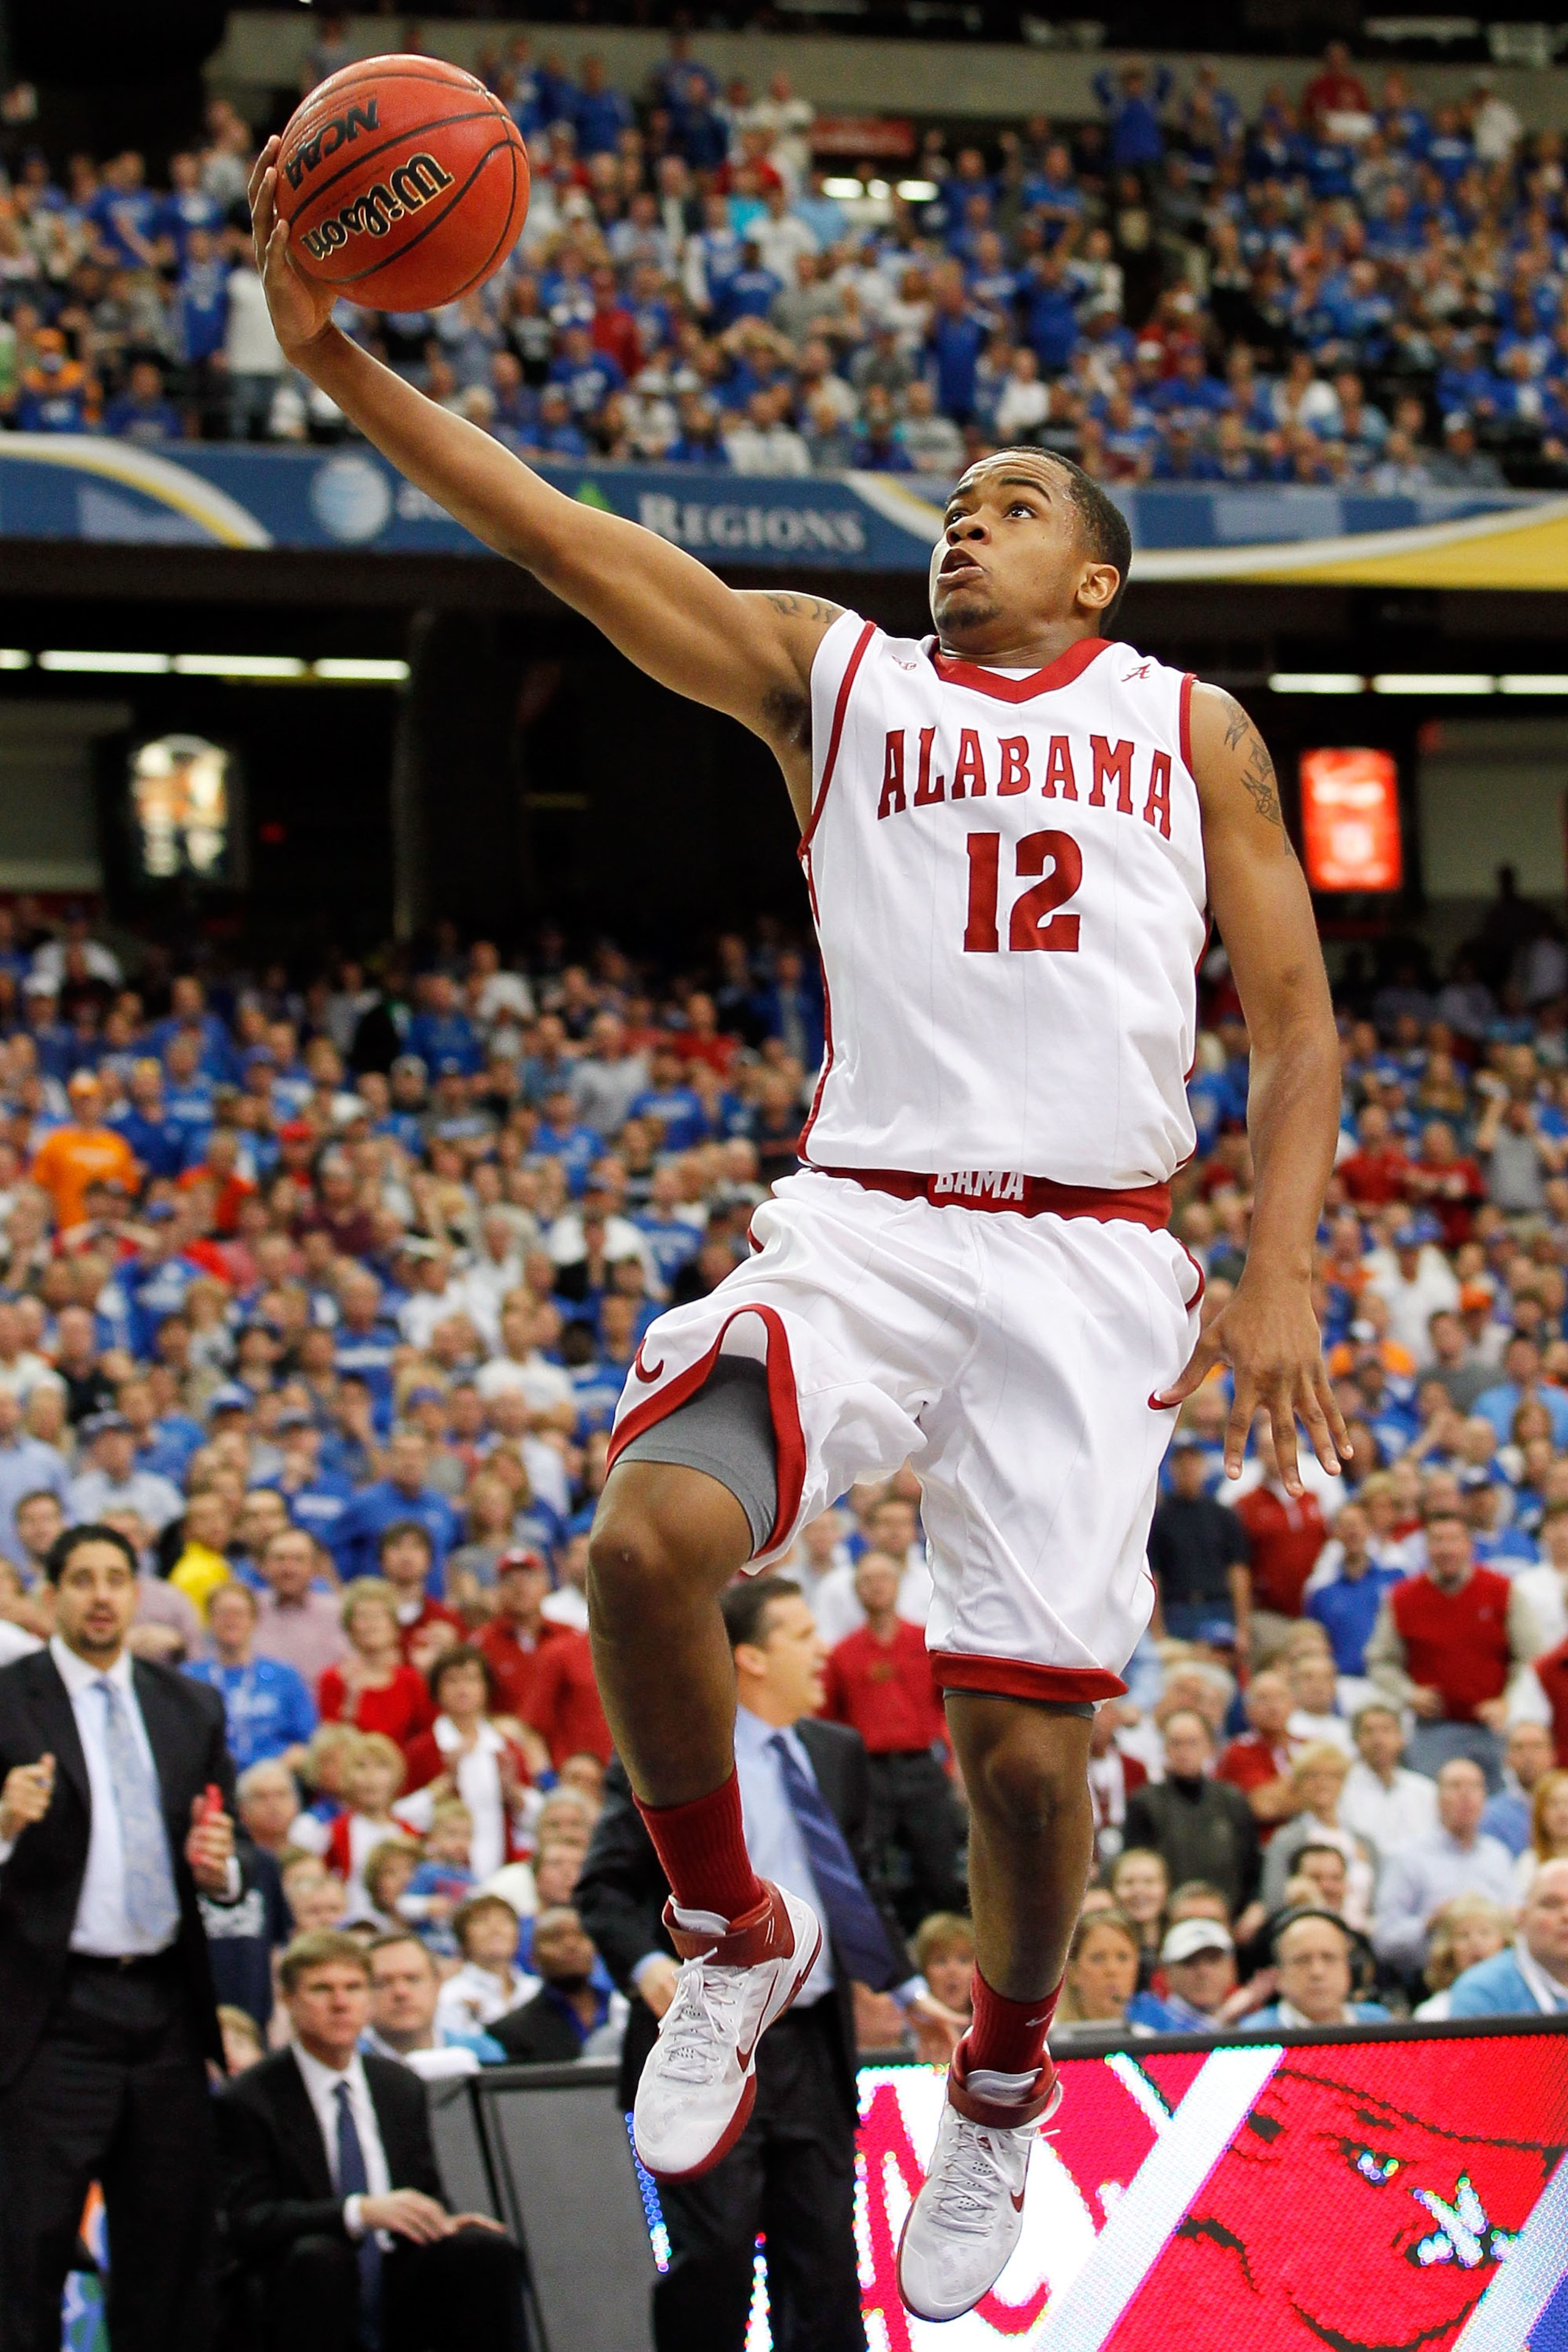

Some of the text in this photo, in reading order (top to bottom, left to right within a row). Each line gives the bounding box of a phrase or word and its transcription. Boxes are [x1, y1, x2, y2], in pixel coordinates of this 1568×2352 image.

[284, 99, 380, 190] NCAA
[300, 153, 455, 261] Wilson
[877, 726, 1172, 842] ALABAMA
[963, 829, 1083, 952] 12
